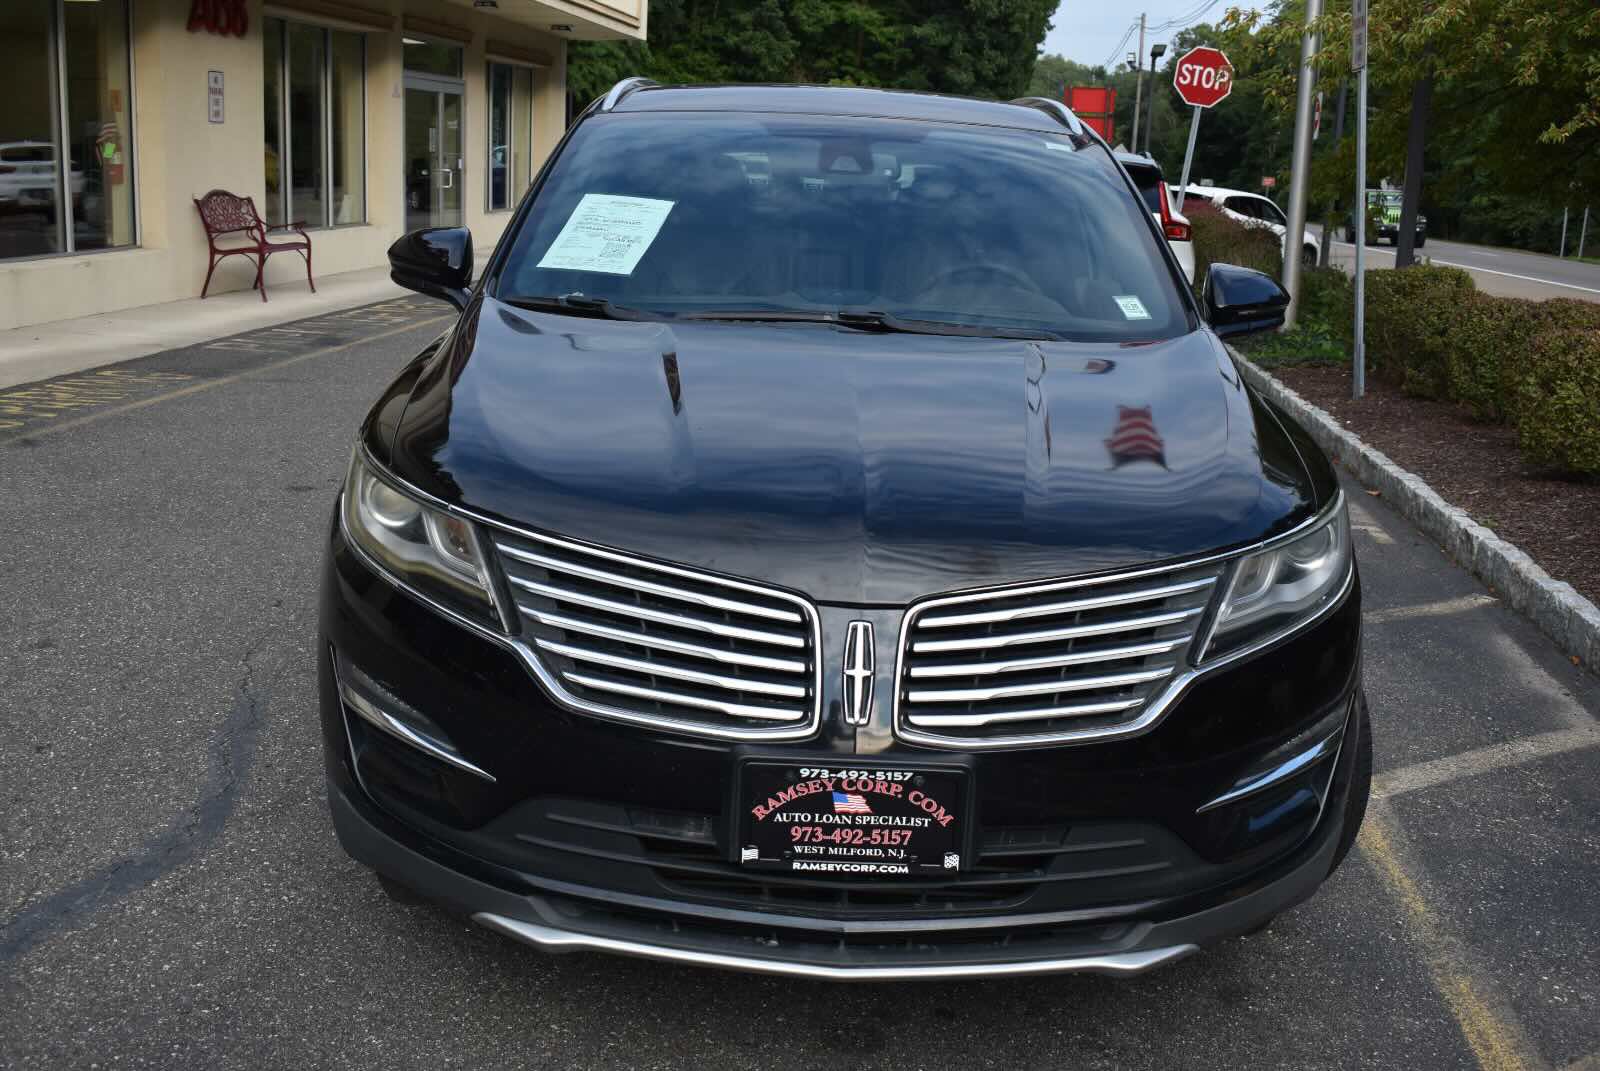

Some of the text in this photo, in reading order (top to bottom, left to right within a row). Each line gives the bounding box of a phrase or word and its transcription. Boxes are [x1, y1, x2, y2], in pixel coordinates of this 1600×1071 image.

[1178, 63, 1229, 91] STOP
[799, 767, 914, 781] 973-492-5157
[751, 778, 955, 827] RAMSEY CORP. COM
[774, 812, 932, 827] AUTO LOAN SPECIALIST
[790, 826, 912, 845] 973-492-5157
[793, 845, 907, 858] WEST MILFORD, N.J.
[792, 862, 909, 874] RAMSEYCORP.COM
